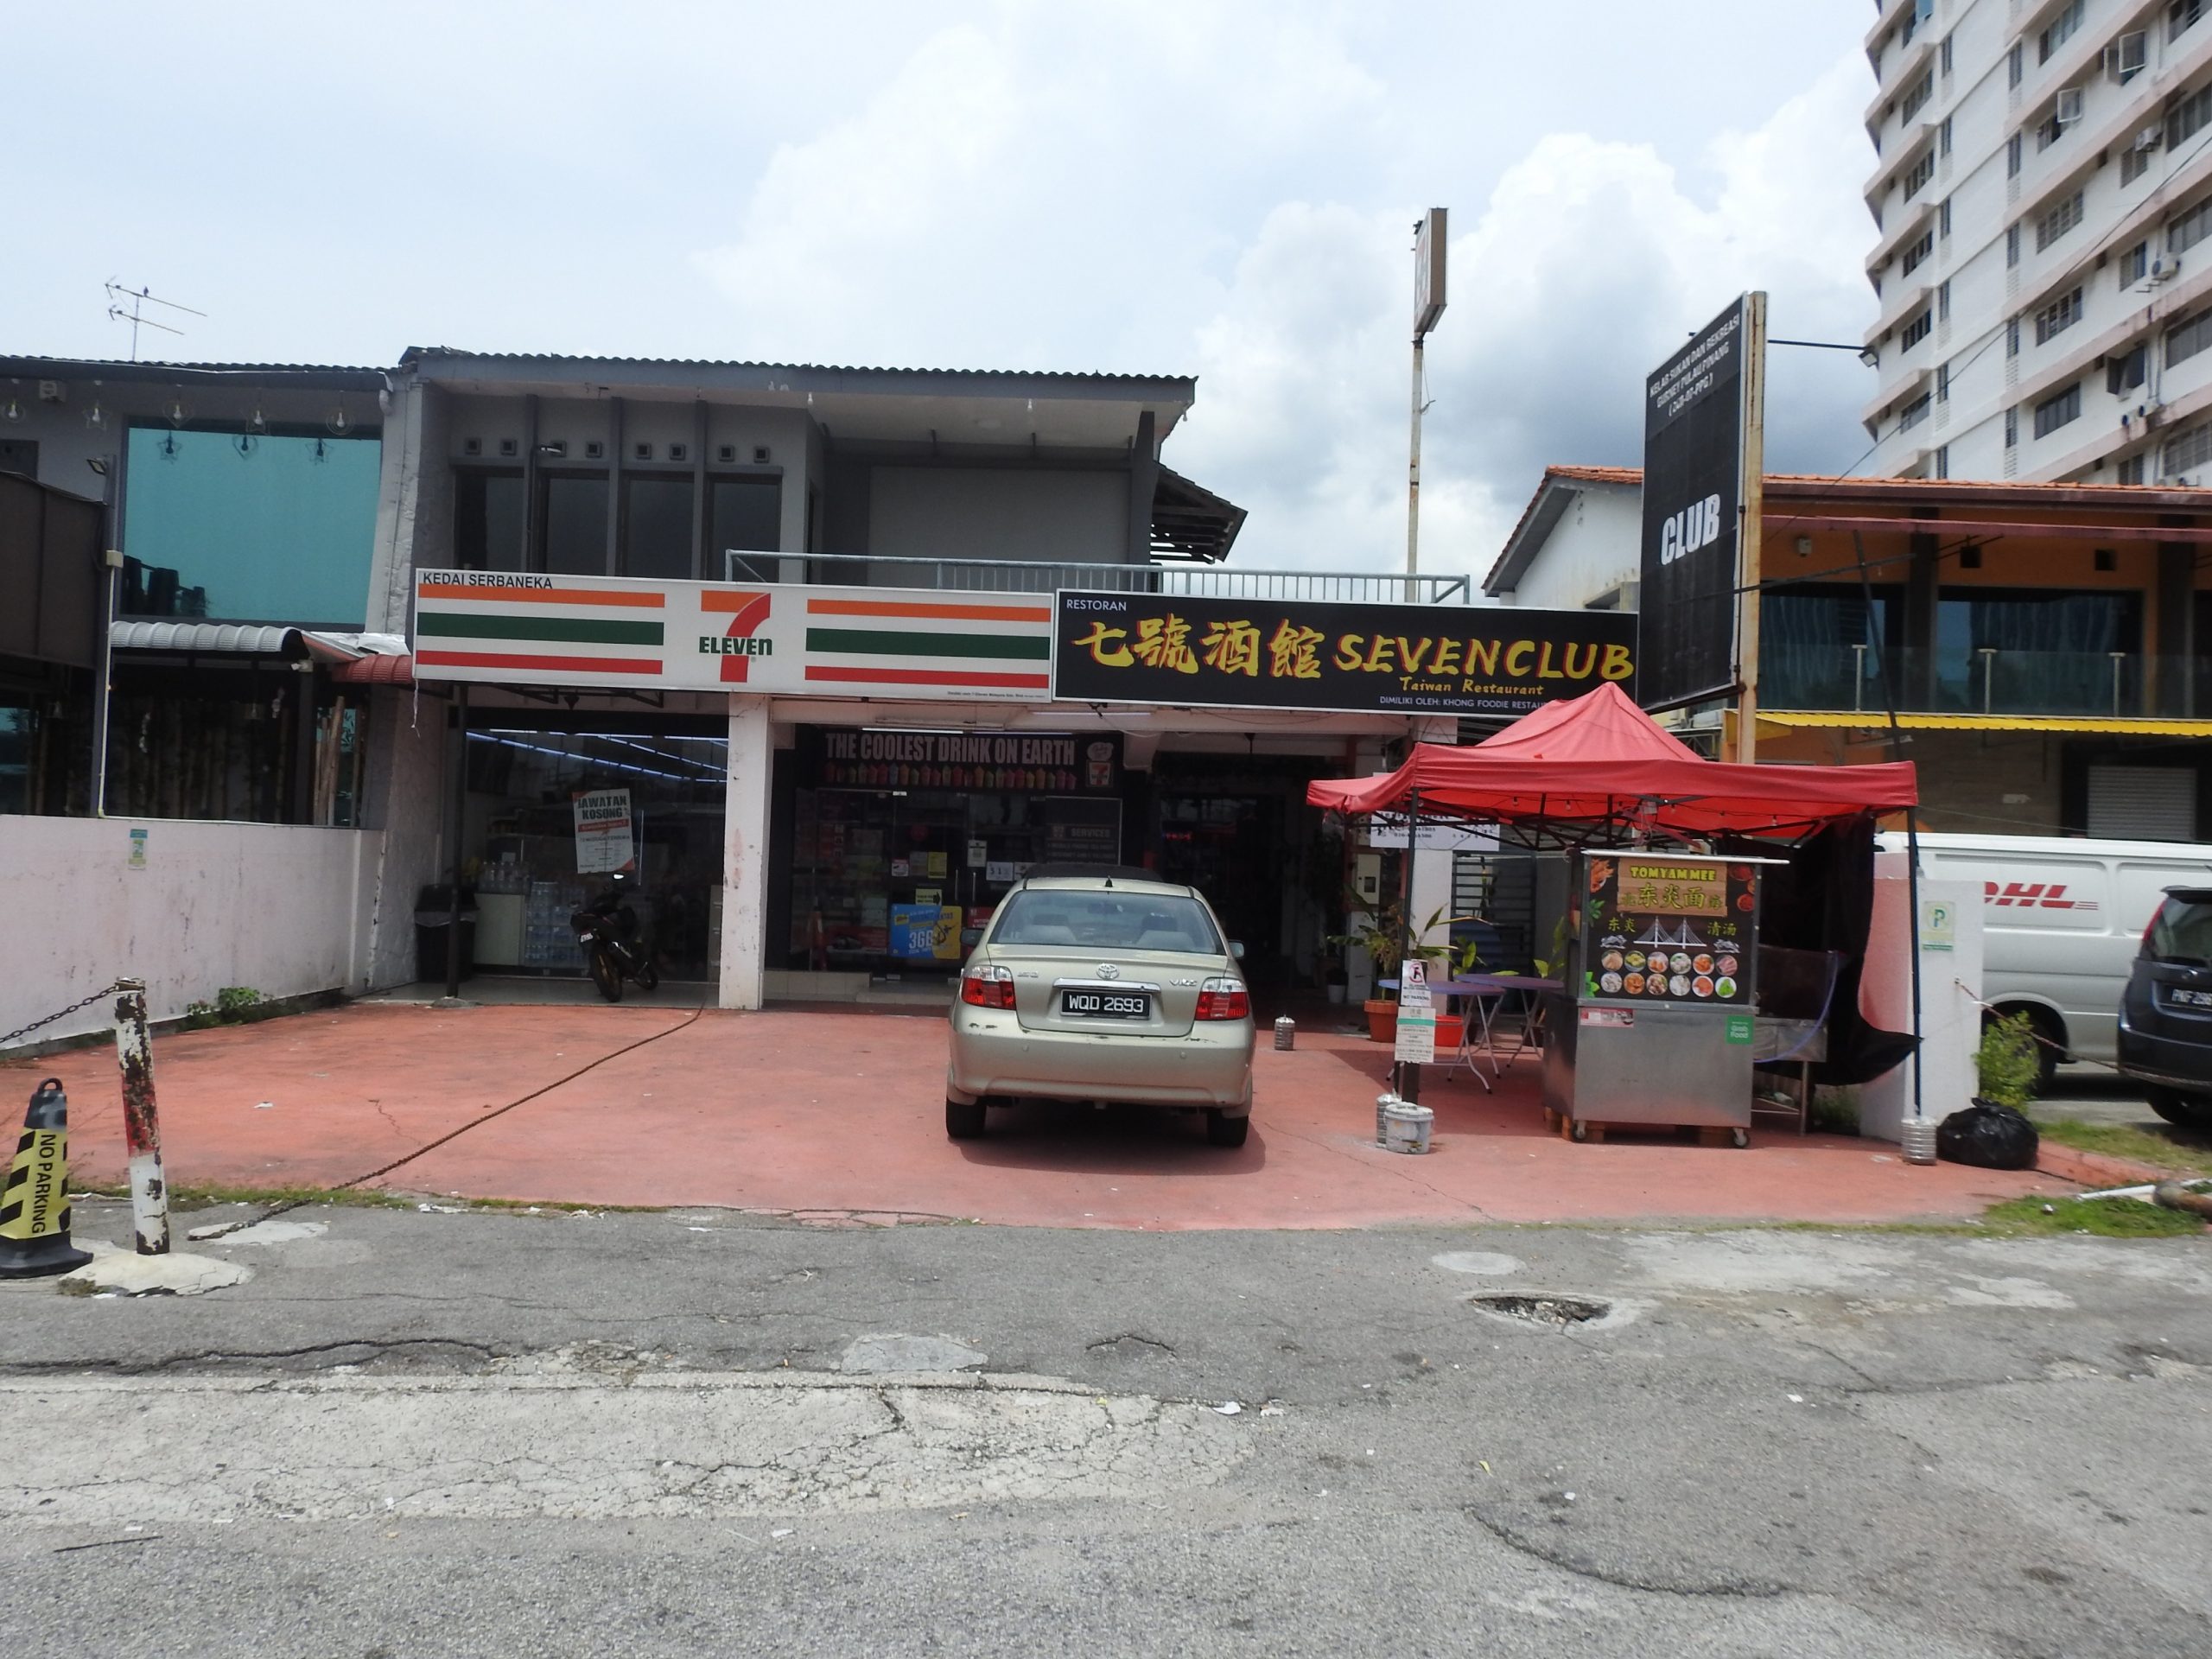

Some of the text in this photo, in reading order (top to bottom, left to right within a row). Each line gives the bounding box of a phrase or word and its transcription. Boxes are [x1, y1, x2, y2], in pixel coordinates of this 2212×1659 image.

[1661, 493, 1720, 566] CLUB
[423, 572, 553, 589] KEDAI SERBANEKA
[1066, 598, 1127, 612] RESTORAN
[701, 590, 771, 682] 7
[1332, 633, 1635, 681] SEVENCLUB
[1399, 677, 1544, 696] Taiwan Restaurant
[1380, 696, 1413, 705] DIMILIKI
[1415, 697, 1441, 706] OLEH:
[1443, 698, 1475, 708] KHONG
[1477, 699, 1509, 709] FOODIE
[825, 733, 856, 760] THE
[861, 734, 934, 761] COOLEST
[938, 735, 989, 764] DRINK
[995, 738, 1018, 764] ON
[1022, 739, 1075, 766] EARTH
[578, 795, 627, 809] JAWATAN
[582, 808, 622, 820] KOSONG
[1630, 866, 1716, 881] TOMYAM MEE
[1068, 994, 1144, 1014] WQD 2693
[32, 1134, 56, 1234] NO PARKING
